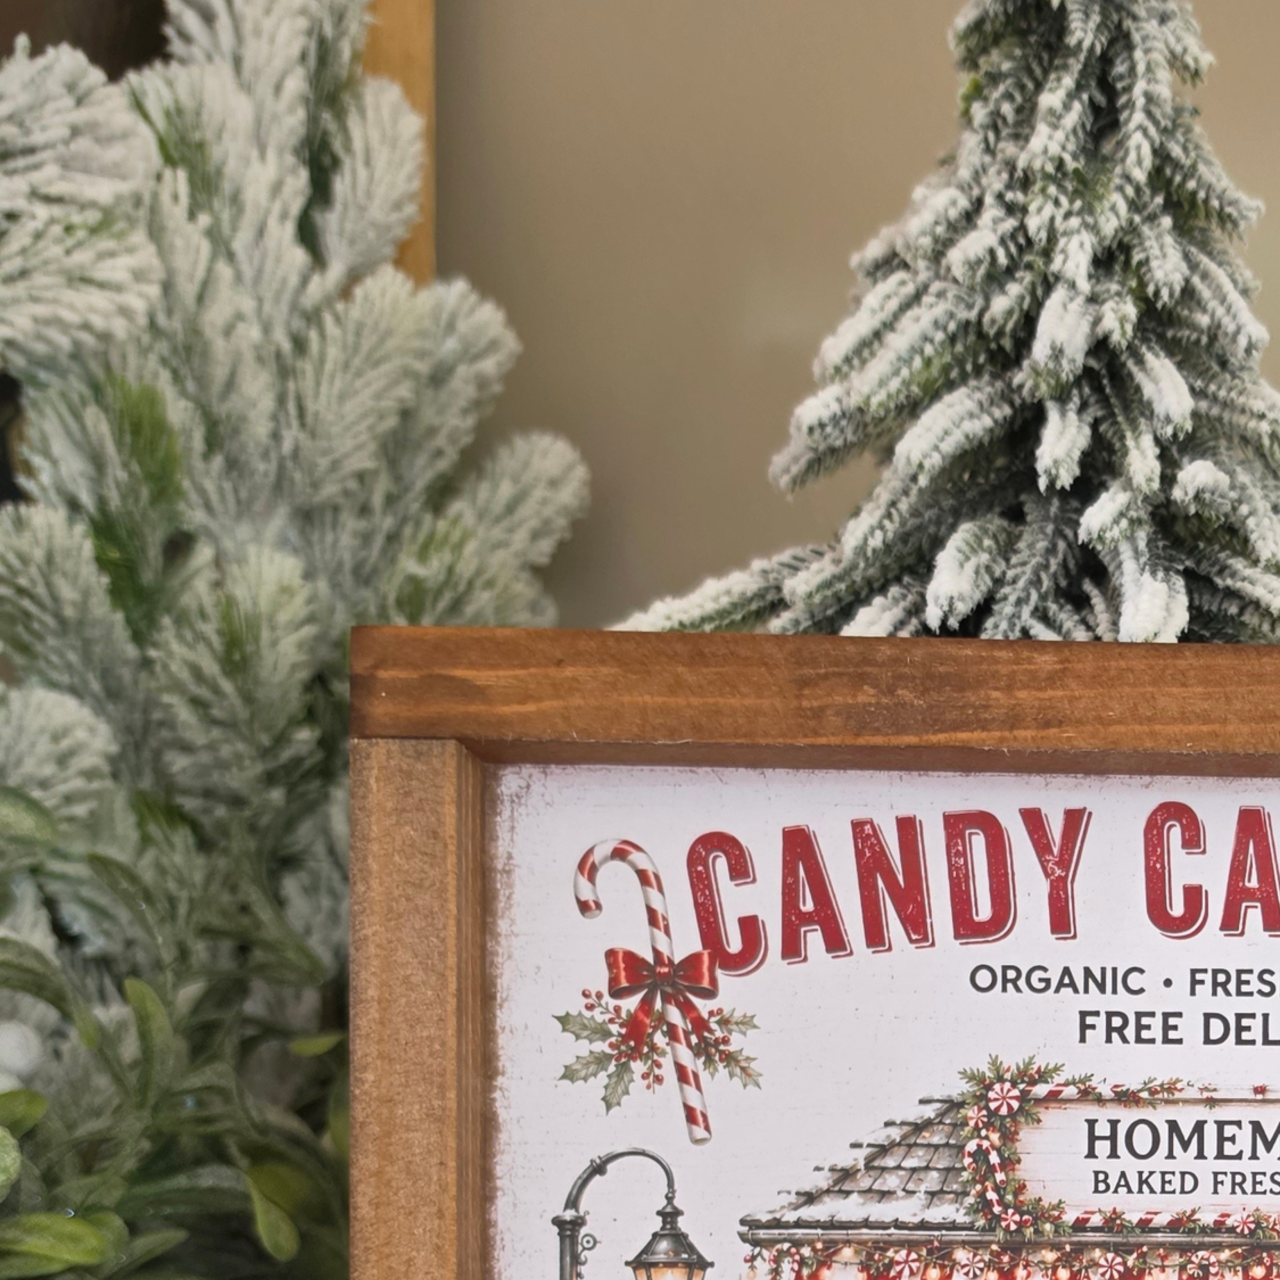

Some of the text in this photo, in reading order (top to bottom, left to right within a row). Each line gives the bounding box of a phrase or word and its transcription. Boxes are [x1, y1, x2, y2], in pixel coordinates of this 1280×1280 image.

[686, 807, 1091, 976] CANDY
[969, 964, 1146, 996] ORGANIC
[1078, 1010, 1183, 1045] FREE
[1092, 1170, 1199, 1196] BAKED
